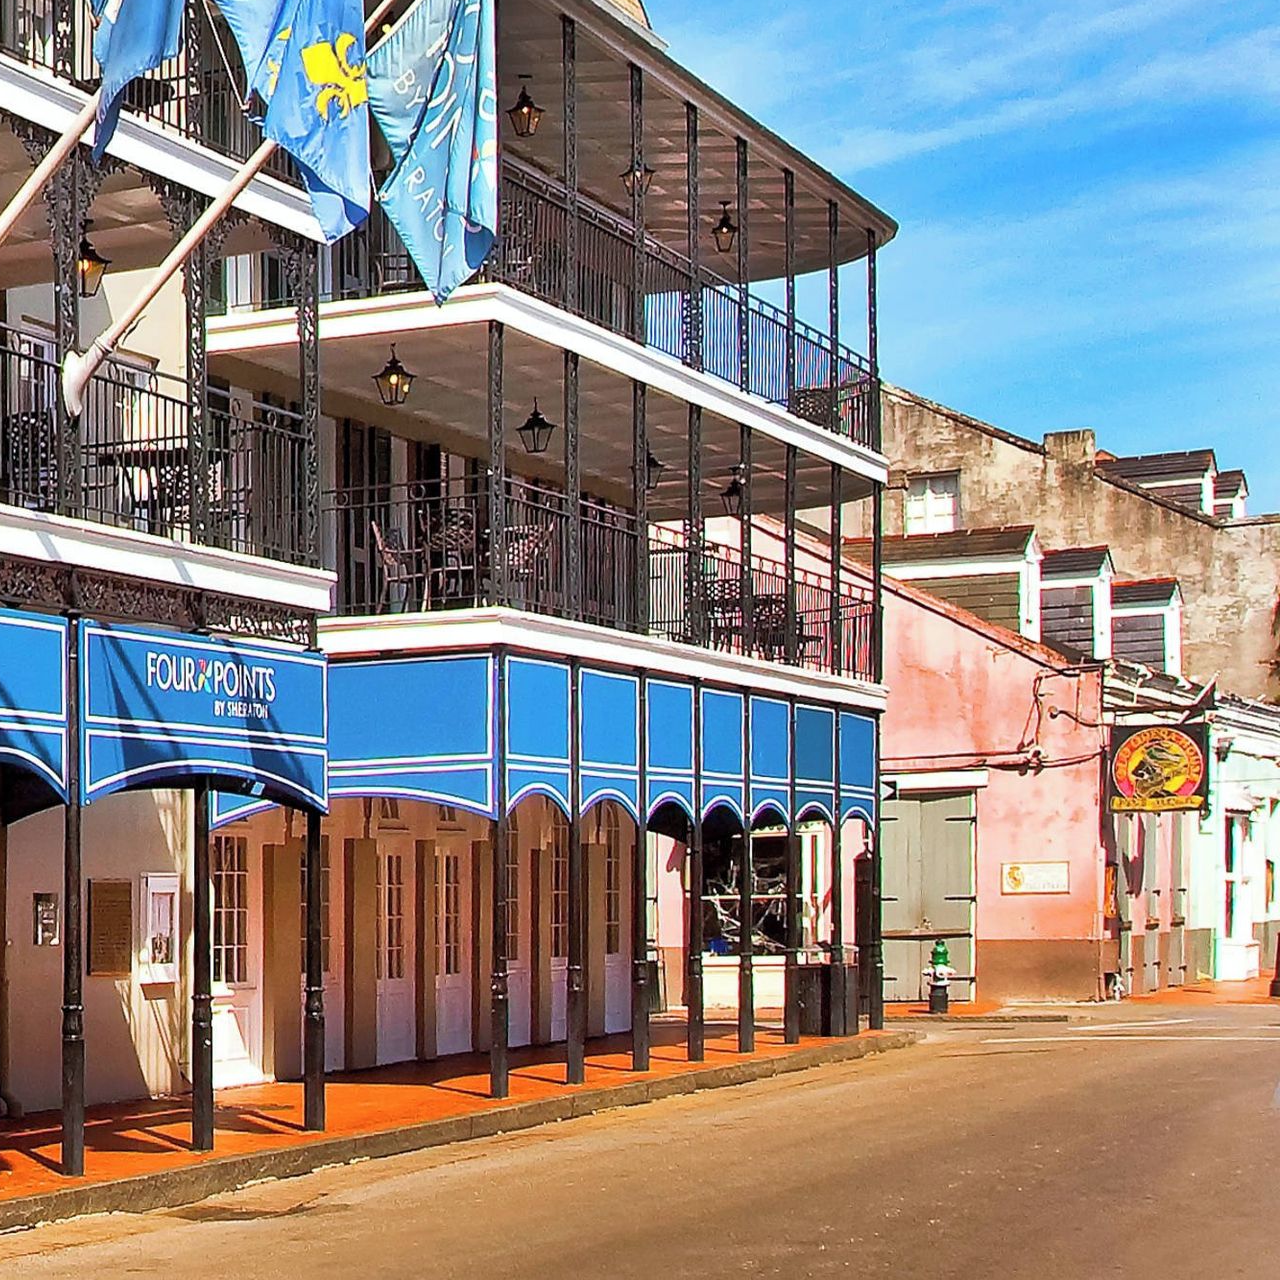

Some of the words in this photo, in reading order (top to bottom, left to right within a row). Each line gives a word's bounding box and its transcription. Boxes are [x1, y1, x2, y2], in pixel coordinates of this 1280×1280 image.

[393, 68, 426, 110] BY
[146, 651, 198, 693] FOUR
[213, 660, 276, 702] POINTS
[214, 700, 225, 717] BY
[227, 701, 268, 719] SHERATON
